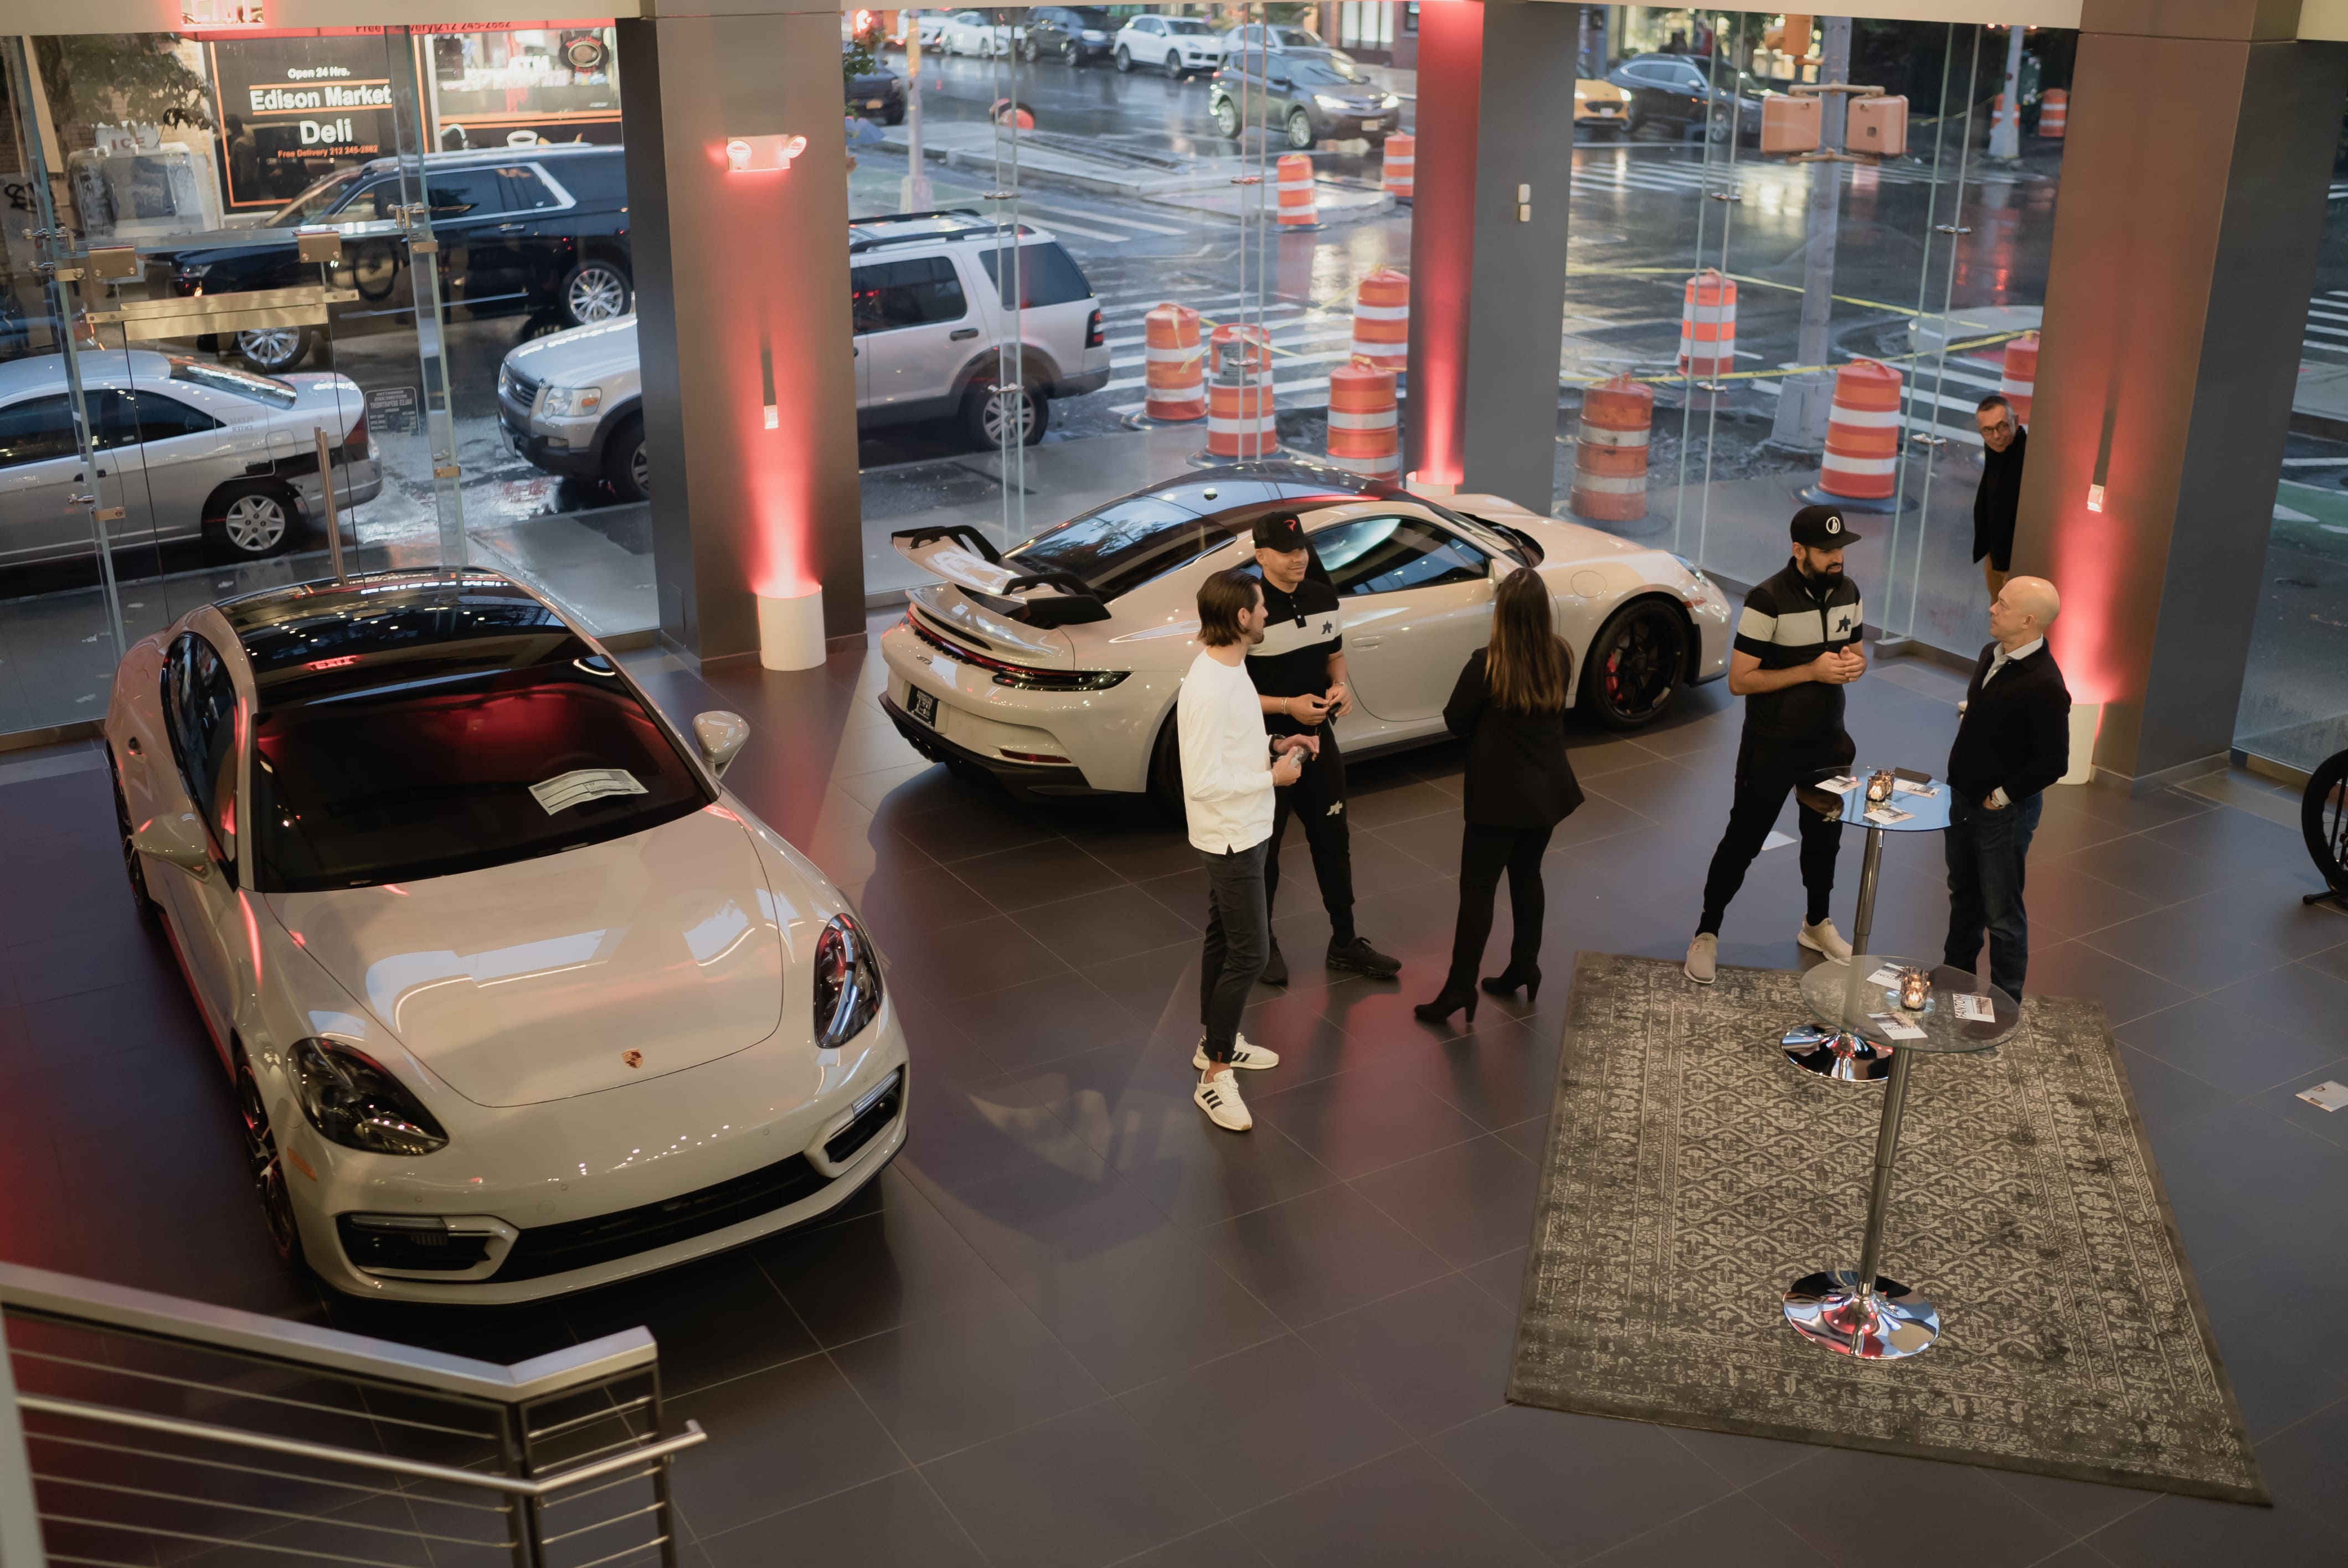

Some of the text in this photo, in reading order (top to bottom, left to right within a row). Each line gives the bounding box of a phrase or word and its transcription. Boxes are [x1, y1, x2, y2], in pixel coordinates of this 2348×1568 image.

[287, 66, 351, 80] Open 24 Hrs.
[250, 85, 392, 111] Edison Market
[300, 118, 353, 145] Deli
[111, 137, 146, 151] ICE
[277, 149, 296, 158] Free
[296, 148, 328, 158] Delivery
[329, 147, 343, 156] 212
[916, 656, 933, 665] GT3
[1876, 972, 1902, 983] ANTOM
[1953, 994, 1968, 1018] FANTOM
